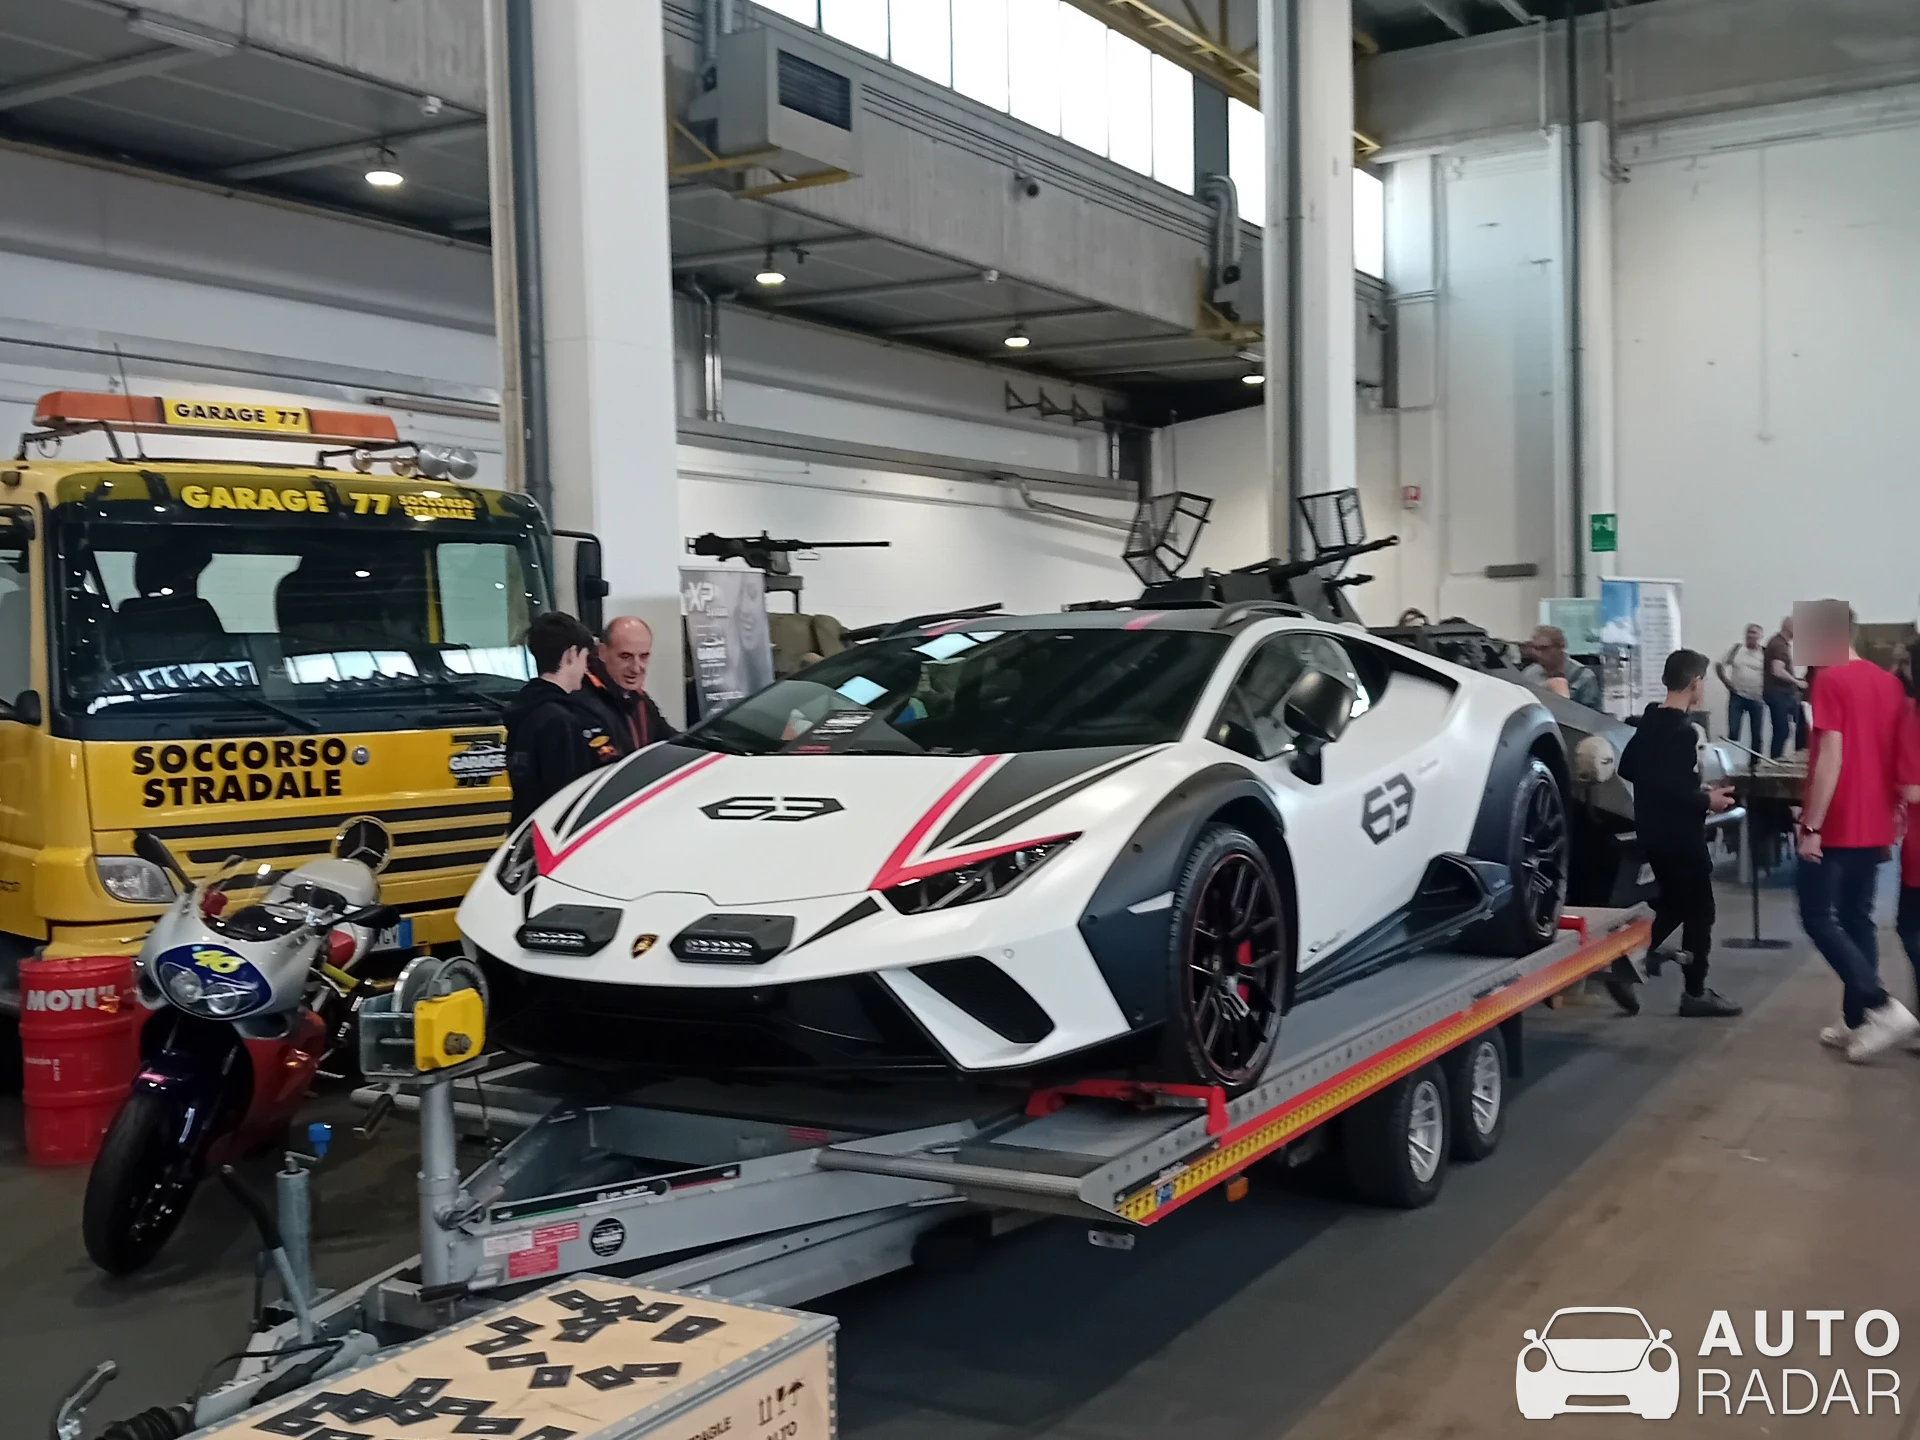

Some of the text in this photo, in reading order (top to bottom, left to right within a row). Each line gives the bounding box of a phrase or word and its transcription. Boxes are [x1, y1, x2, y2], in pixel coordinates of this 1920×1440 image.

[175, 403, 301, 425] GARAGE 77
[181, 485, 391, 515] GARAGE 77
[398, 495, 475, 509] SOCCORSO
[404, 506, 477, 520] STRADALE
[132, 738, 346, 775] SOCCORSO
[449, 753, 507, 771] GARAGE
[142, 769, 342, 808] STRADALE
[698, 796, 846, 822] 63
[1361, 773, 1416, 845] 63
[192, 950, 247, 974] 46
